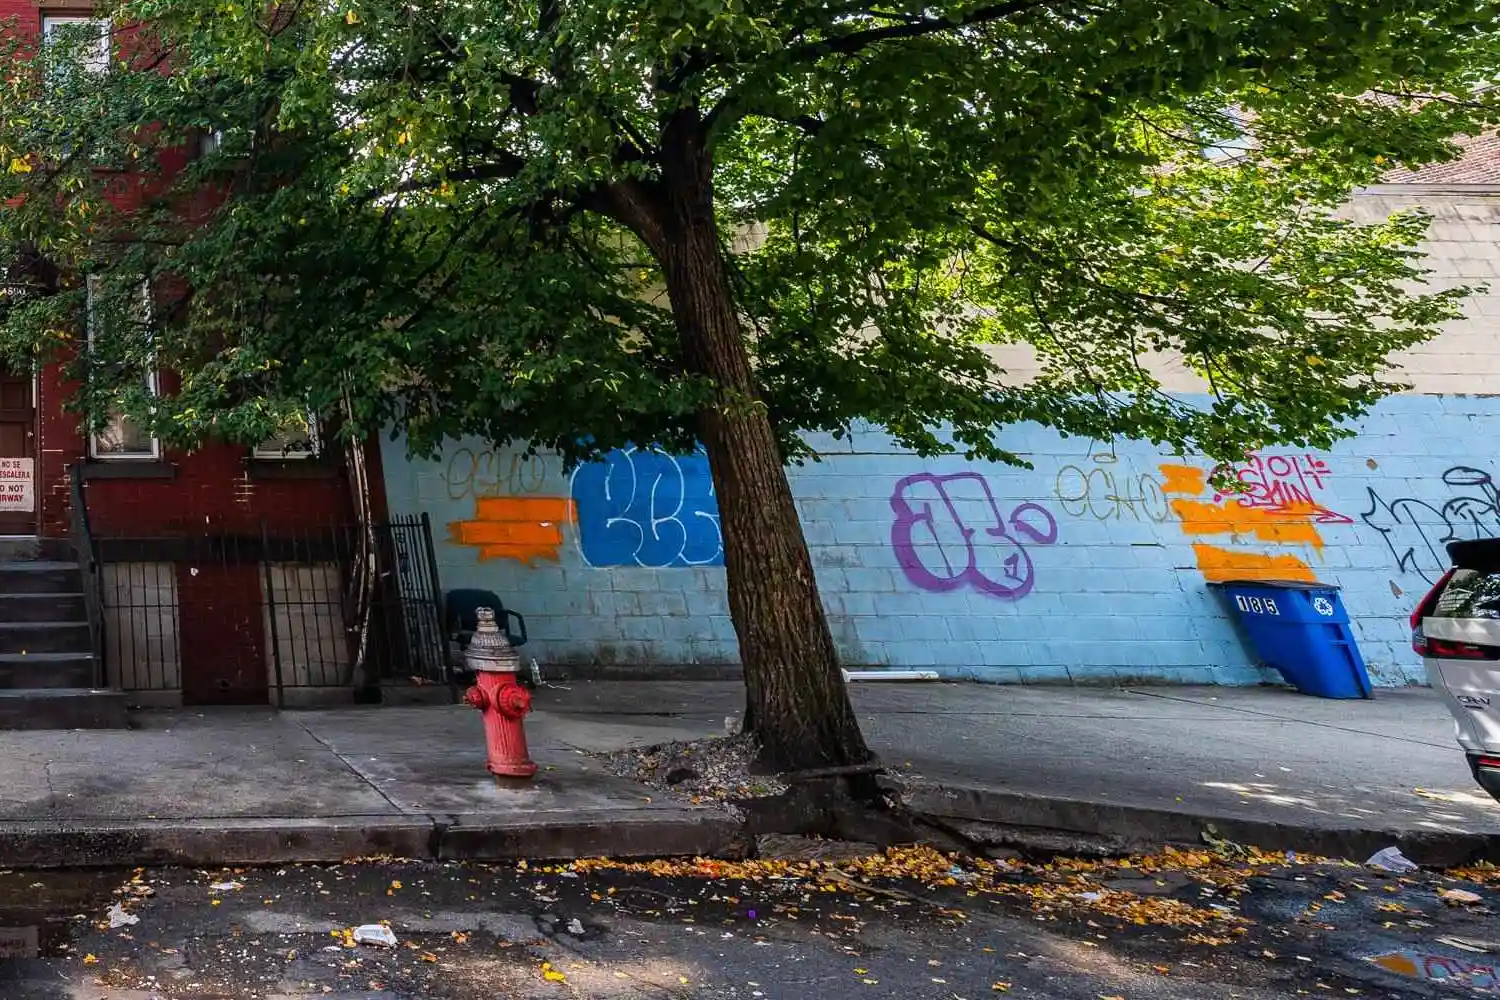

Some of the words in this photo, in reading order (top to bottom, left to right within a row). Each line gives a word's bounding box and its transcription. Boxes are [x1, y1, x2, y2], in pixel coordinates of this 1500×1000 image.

[1, 460, 11, 468] NO
[13, 460, 21, 469] SE
[8, 484, 25, 493] NOT
[1237, 596, 1279, 615] 185
